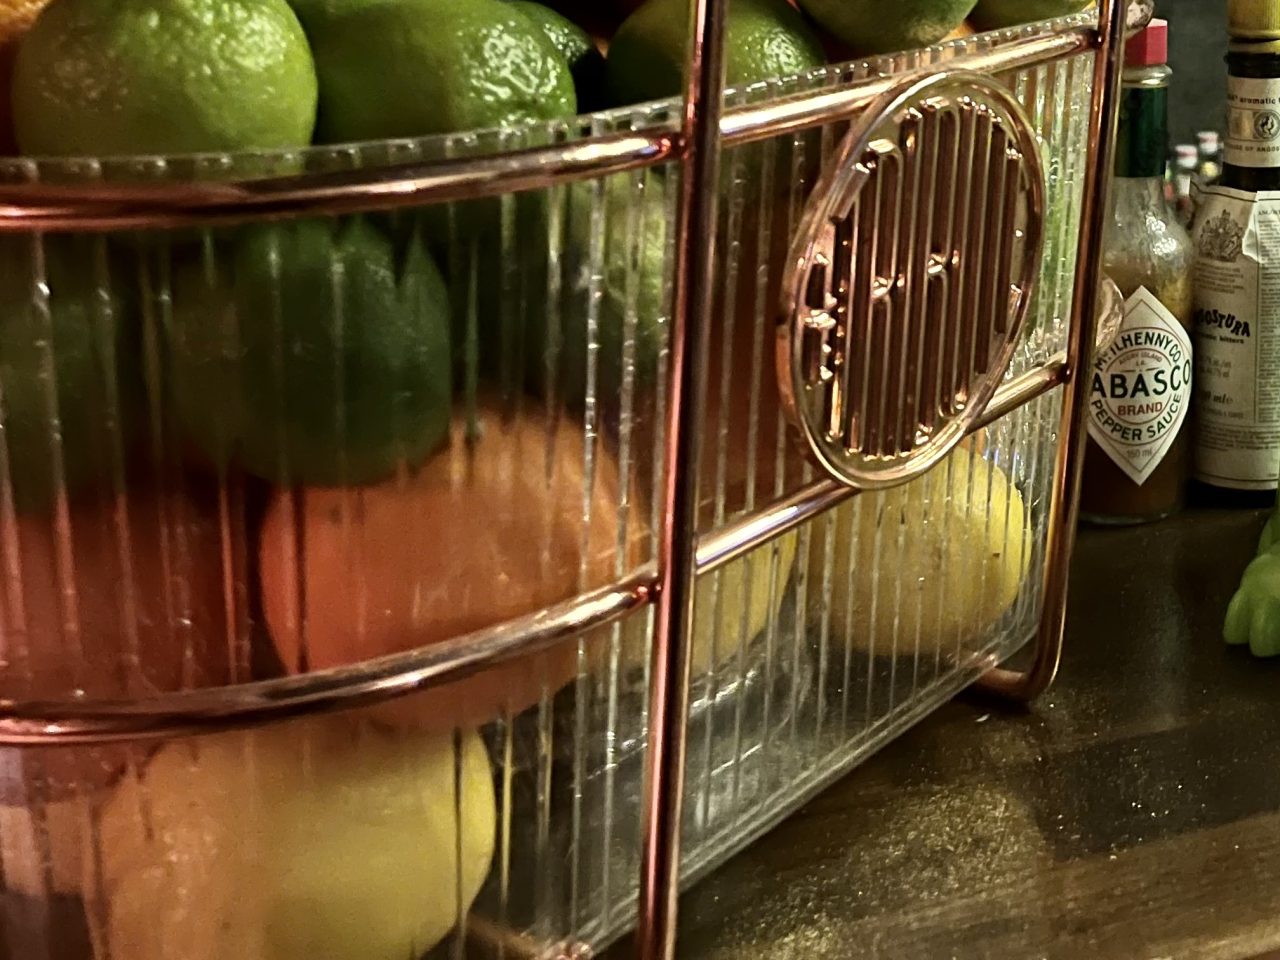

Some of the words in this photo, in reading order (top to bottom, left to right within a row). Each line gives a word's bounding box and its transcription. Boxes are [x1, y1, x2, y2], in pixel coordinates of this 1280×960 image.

[1239, 97, 1276, 105] aromatic
[1091, 360, 1192, 399] ABASCO
[1117, 400, 1163, 417] BRAND
[1091, 399, 1143, 441] PEPPER
[1147, 394, 1182, 439] SAUCE
[1141, 446, 1153, 458] ml
